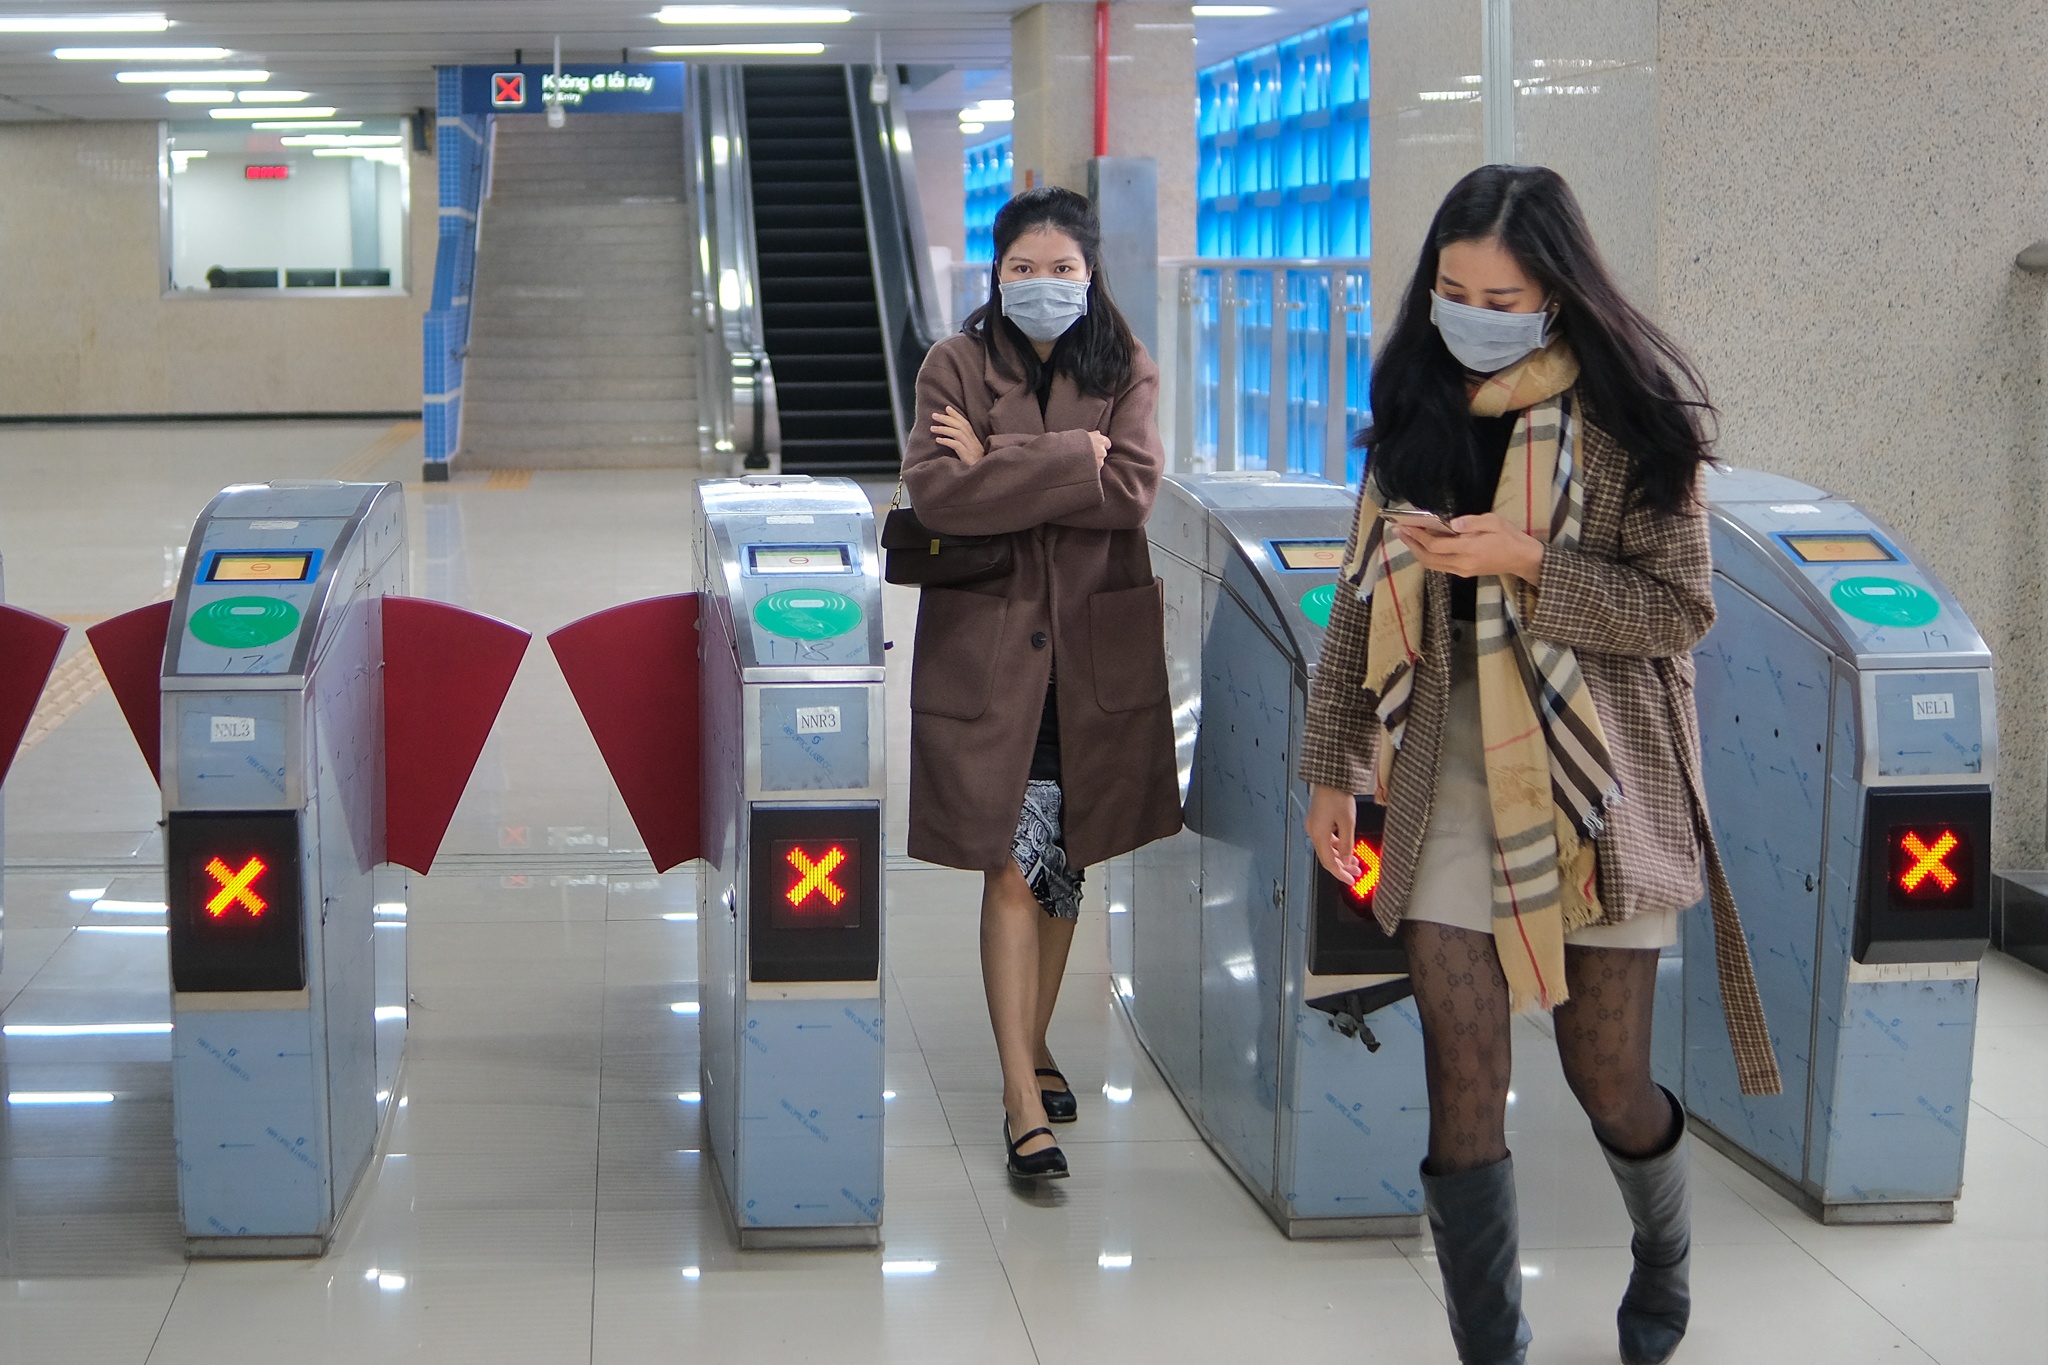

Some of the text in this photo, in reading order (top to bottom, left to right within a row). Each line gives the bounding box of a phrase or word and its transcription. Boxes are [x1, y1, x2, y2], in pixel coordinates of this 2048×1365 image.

[591, 73, 606, 88] đi
[628, 73, 655, 91] này
[794, 641, 834, 662] 18
[1916, 701, 1949, 715] NEL1
[801, 714, 836, 728] NNR3
[215, 723, 251, 737] NNL3
